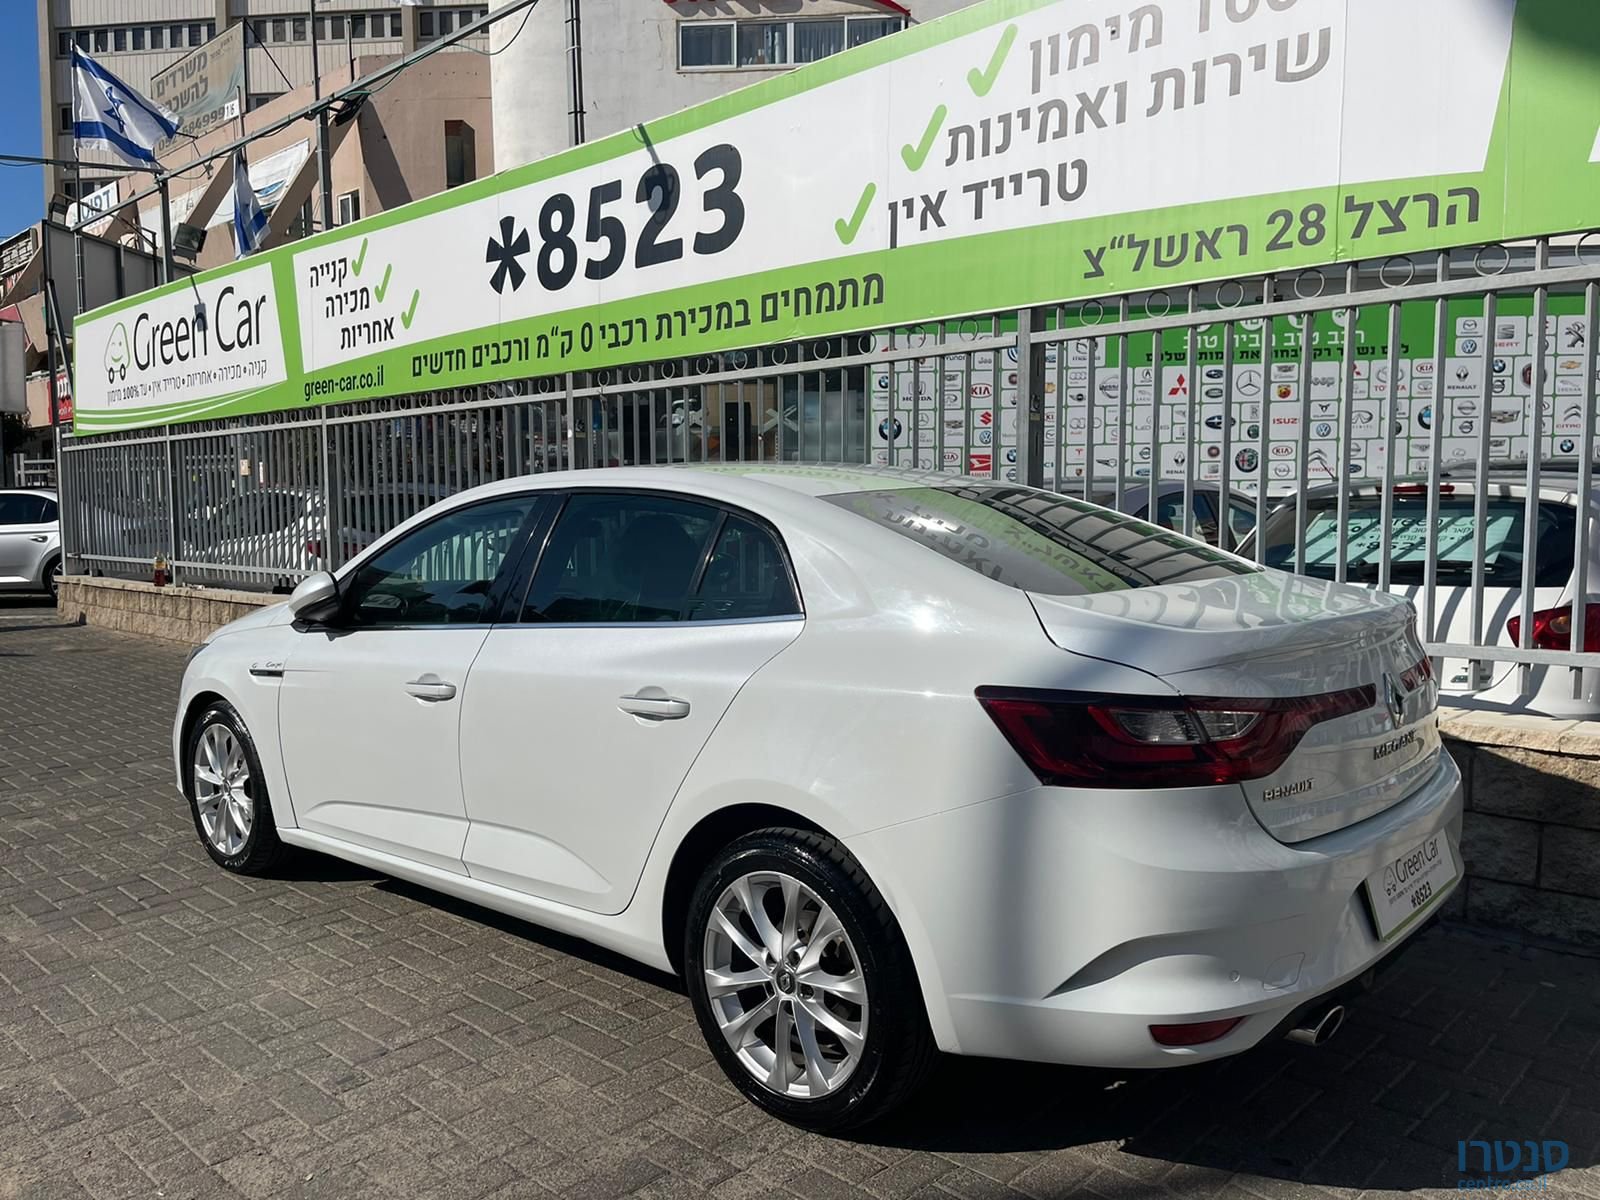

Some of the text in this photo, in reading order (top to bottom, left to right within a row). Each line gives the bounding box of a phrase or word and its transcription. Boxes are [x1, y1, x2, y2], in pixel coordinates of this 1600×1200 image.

[1030, 4, 1163, 94] מימון
[156, 51, 208, 98] משרדים
[945, 26, 1332, 167] שירות ואמינות
[887, 158, 1088, 249] טרייד אין
[1344, 186, 1481, 241] הרצל
[1265, 203, 1327, 252] 28
[310, 257, 348, 288] קנייה
[325, 287, 370, 318] מכירה
[761, 273, 884, 323] מתמחים
[133, 286, 266, 371] Green Car
[340, 317, 395, 350] אחריות
[601, 317, 648, 349] רכבי
[655, 298, 752, 341] במכירת
[412, 348, 466, 377] חדשים
[473, 336, 529, 368] ורכבים
[304, 365, 384, 401] green-car.co.il
[1263, 777, 1315, 802] RENAULT
[1395, 851, 1425, 883] Green
